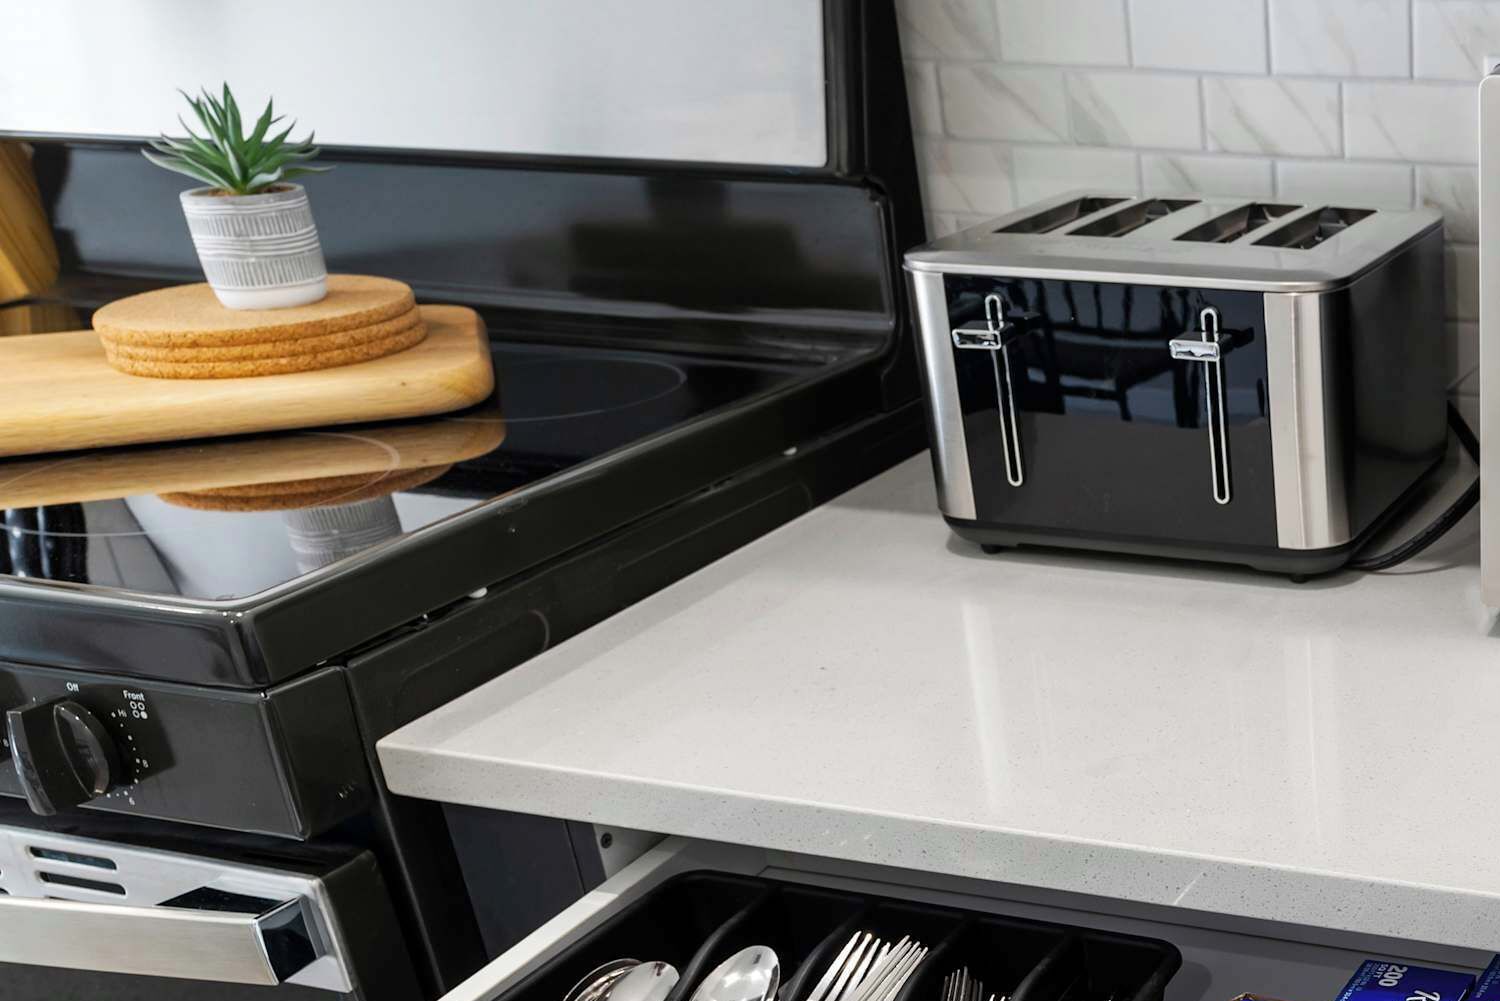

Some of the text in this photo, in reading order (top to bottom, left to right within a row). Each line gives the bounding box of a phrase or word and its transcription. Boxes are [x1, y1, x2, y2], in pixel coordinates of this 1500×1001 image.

[66, 681, 80, 692] Off
[123, 689, 145, 701] Front
[118, 709, 127, 717] Hi
[1378, 964, 1408, 987] 200
